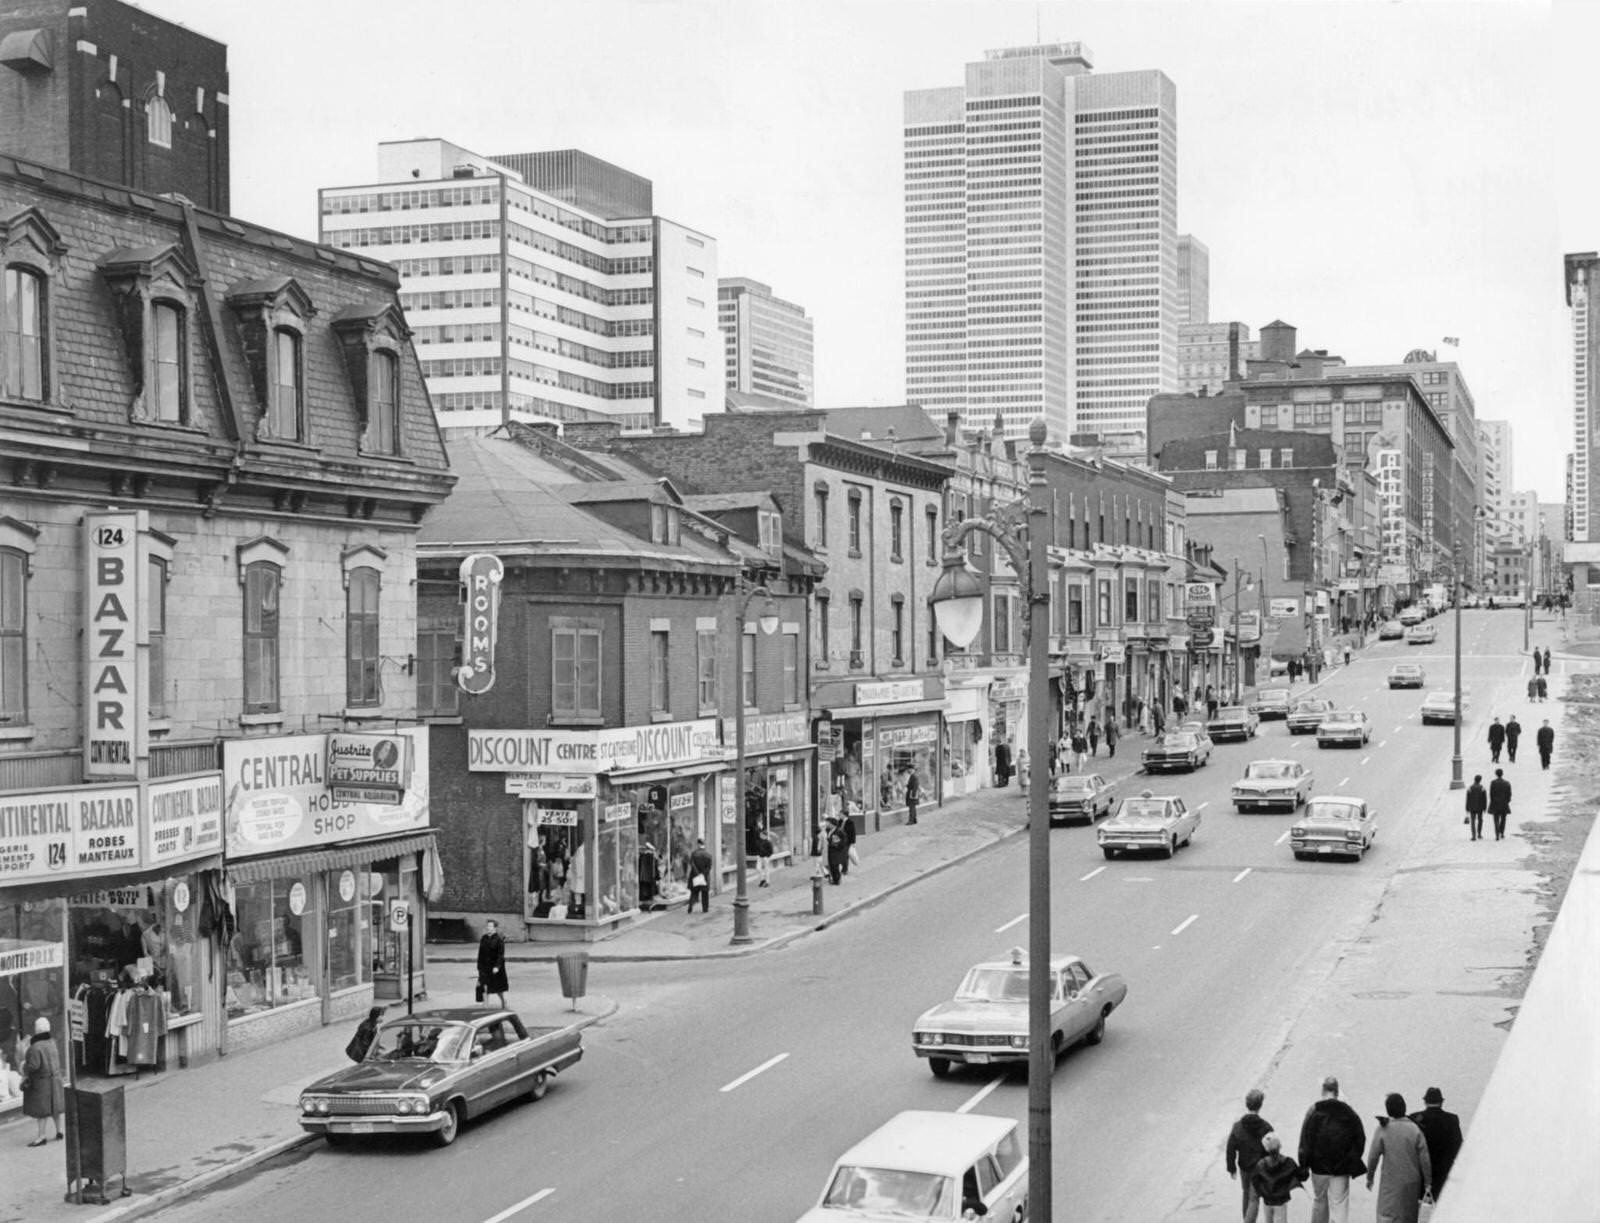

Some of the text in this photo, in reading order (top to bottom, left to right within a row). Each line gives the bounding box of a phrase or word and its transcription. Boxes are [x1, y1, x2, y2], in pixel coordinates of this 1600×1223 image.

[98, 528, 124, 545] 124
[473, 575, 489, 672] ROOMS
[93, 556, 129, 730] BAZAR
[328, 738, 372, 764] Justrite
[469, 736, 598, 766] DISCOUNT CENTRE
[636, 725, 693, 763] DISCOUNT
[240, 753, 322, 792] CENTRAL
[330, 767, 398, 783] PET SUPPLIES
[80, 797, 135, 832] BAZAAR
[314, 813, 356, 836] SHOP
[48, 841, 66, 865] 124
[88, 835, 125, 849] ROBES
[0, 853, 35, 863] MENTS
[78, 848, 135, 864] MANTEAUX
[29, 947, 55, 968] PRIX
